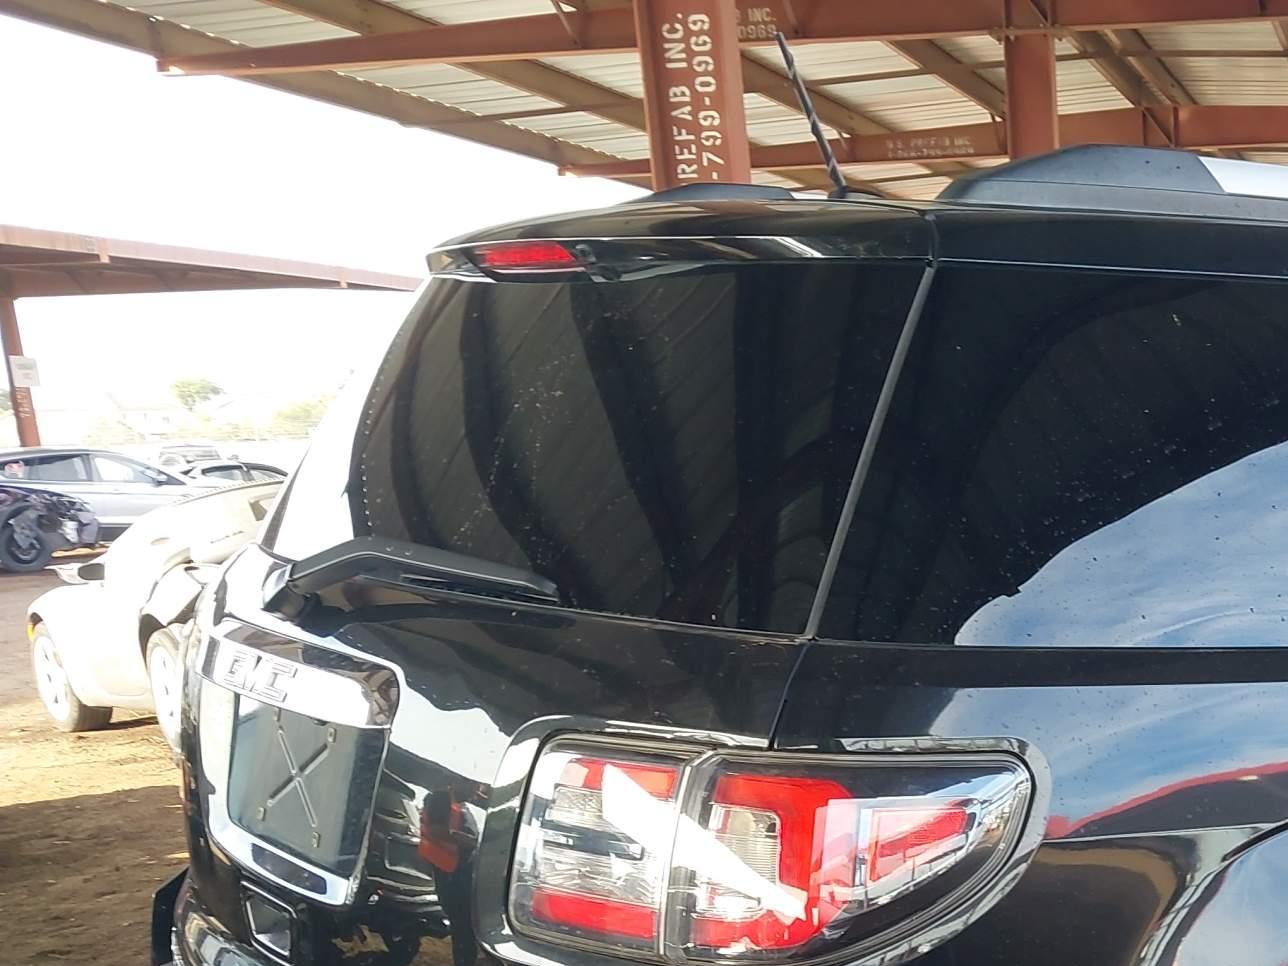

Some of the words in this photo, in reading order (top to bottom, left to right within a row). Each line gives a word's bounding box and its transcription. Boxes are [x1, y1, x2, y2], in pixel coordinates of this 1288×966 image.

[661, 13, 689, 69] INC.
[736, 24, 777, 39] 0969
[668, 85, 699, 181] REFAB
[687, 13, 726, 181] -799-0969
